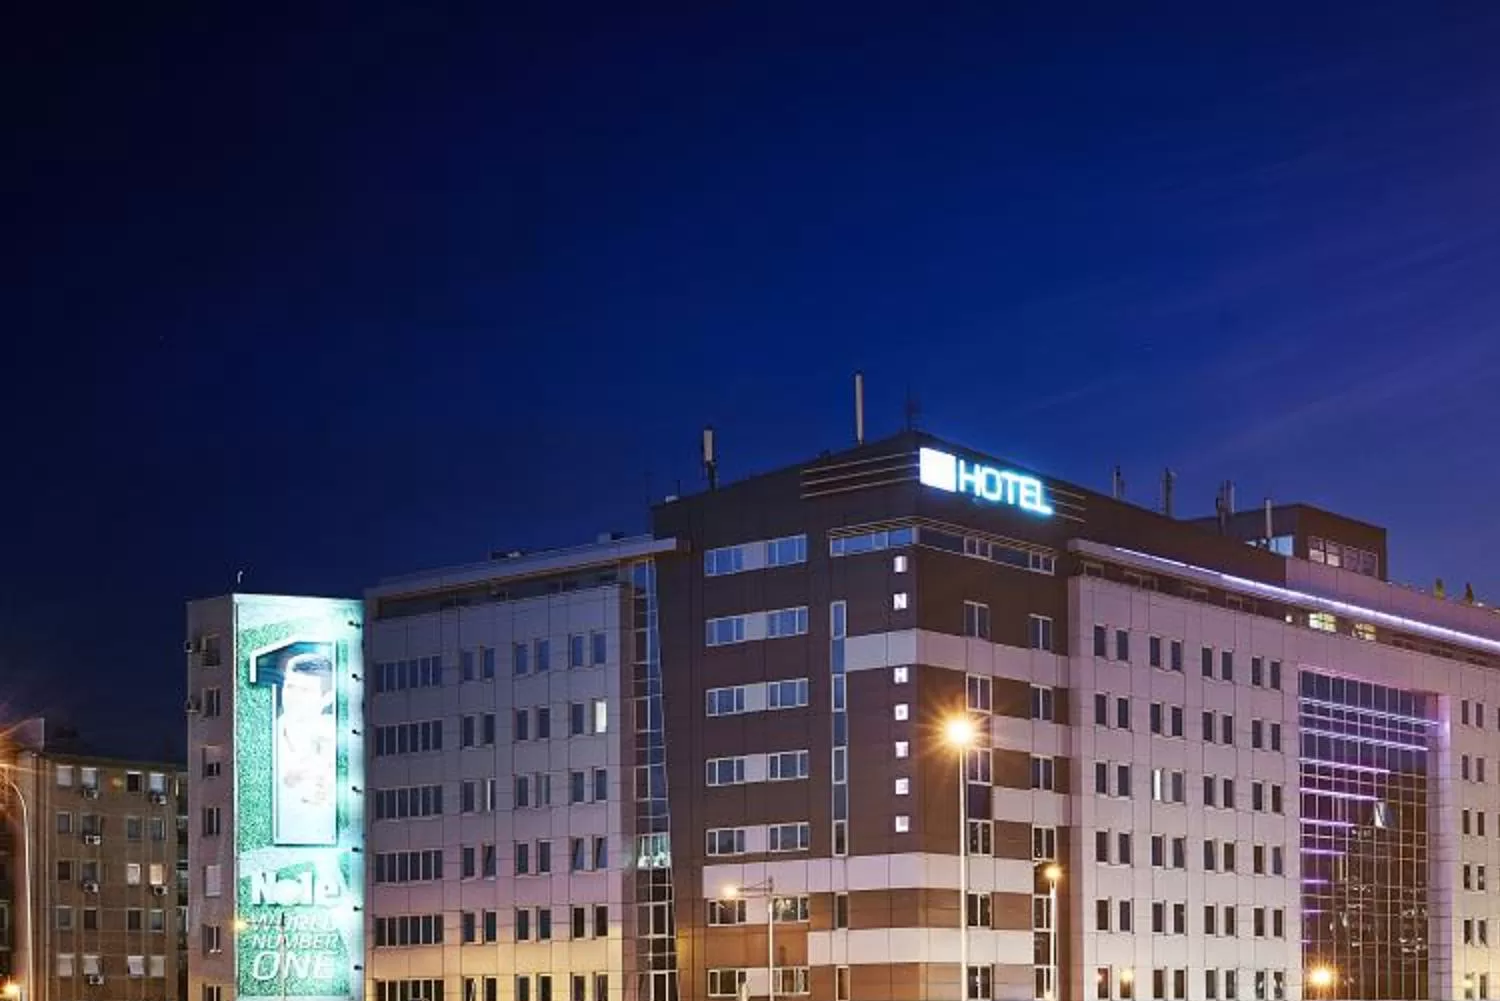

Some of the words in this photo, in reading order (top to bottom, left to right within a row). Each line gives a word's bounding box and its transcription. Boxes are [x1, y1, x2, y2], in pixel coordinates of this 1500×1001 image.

[959, 459, 1053, 515] HOTEL
[893, 666, 909, 833] HOTEL
[252, 933, 338, 950] NUMBER
[253, 951, 335, 980] ONE
